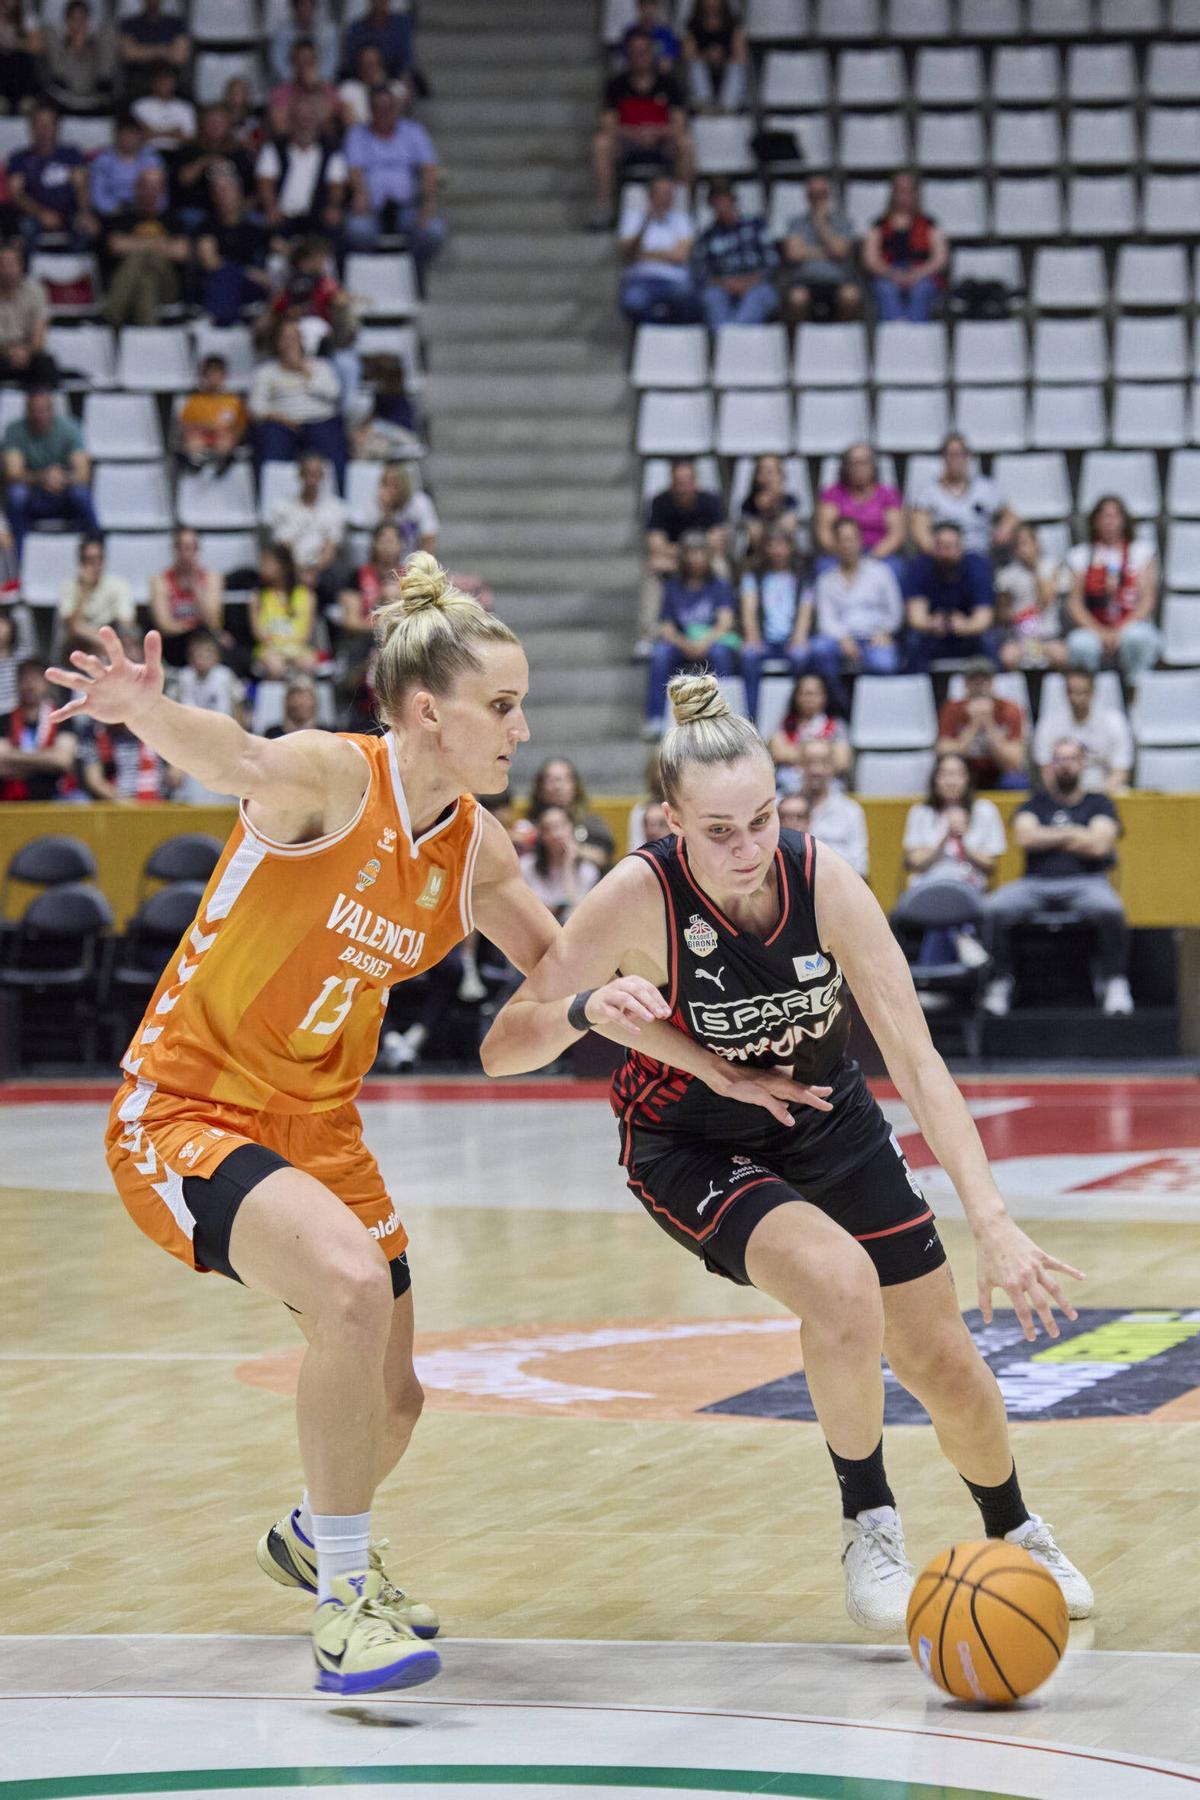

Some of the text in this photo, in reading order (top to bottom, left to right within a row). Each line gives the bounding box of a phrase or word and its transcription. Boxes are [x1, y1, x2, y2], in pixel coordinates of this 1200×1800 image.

[326, 893, 425, 968] VALENCIA
[687, 939, 717, 948] GIRONA
[338, 946, 393, 978] BASKET
[299, 975, 360, 1035] 13
[702, 995, 809, 1031] SPAR
